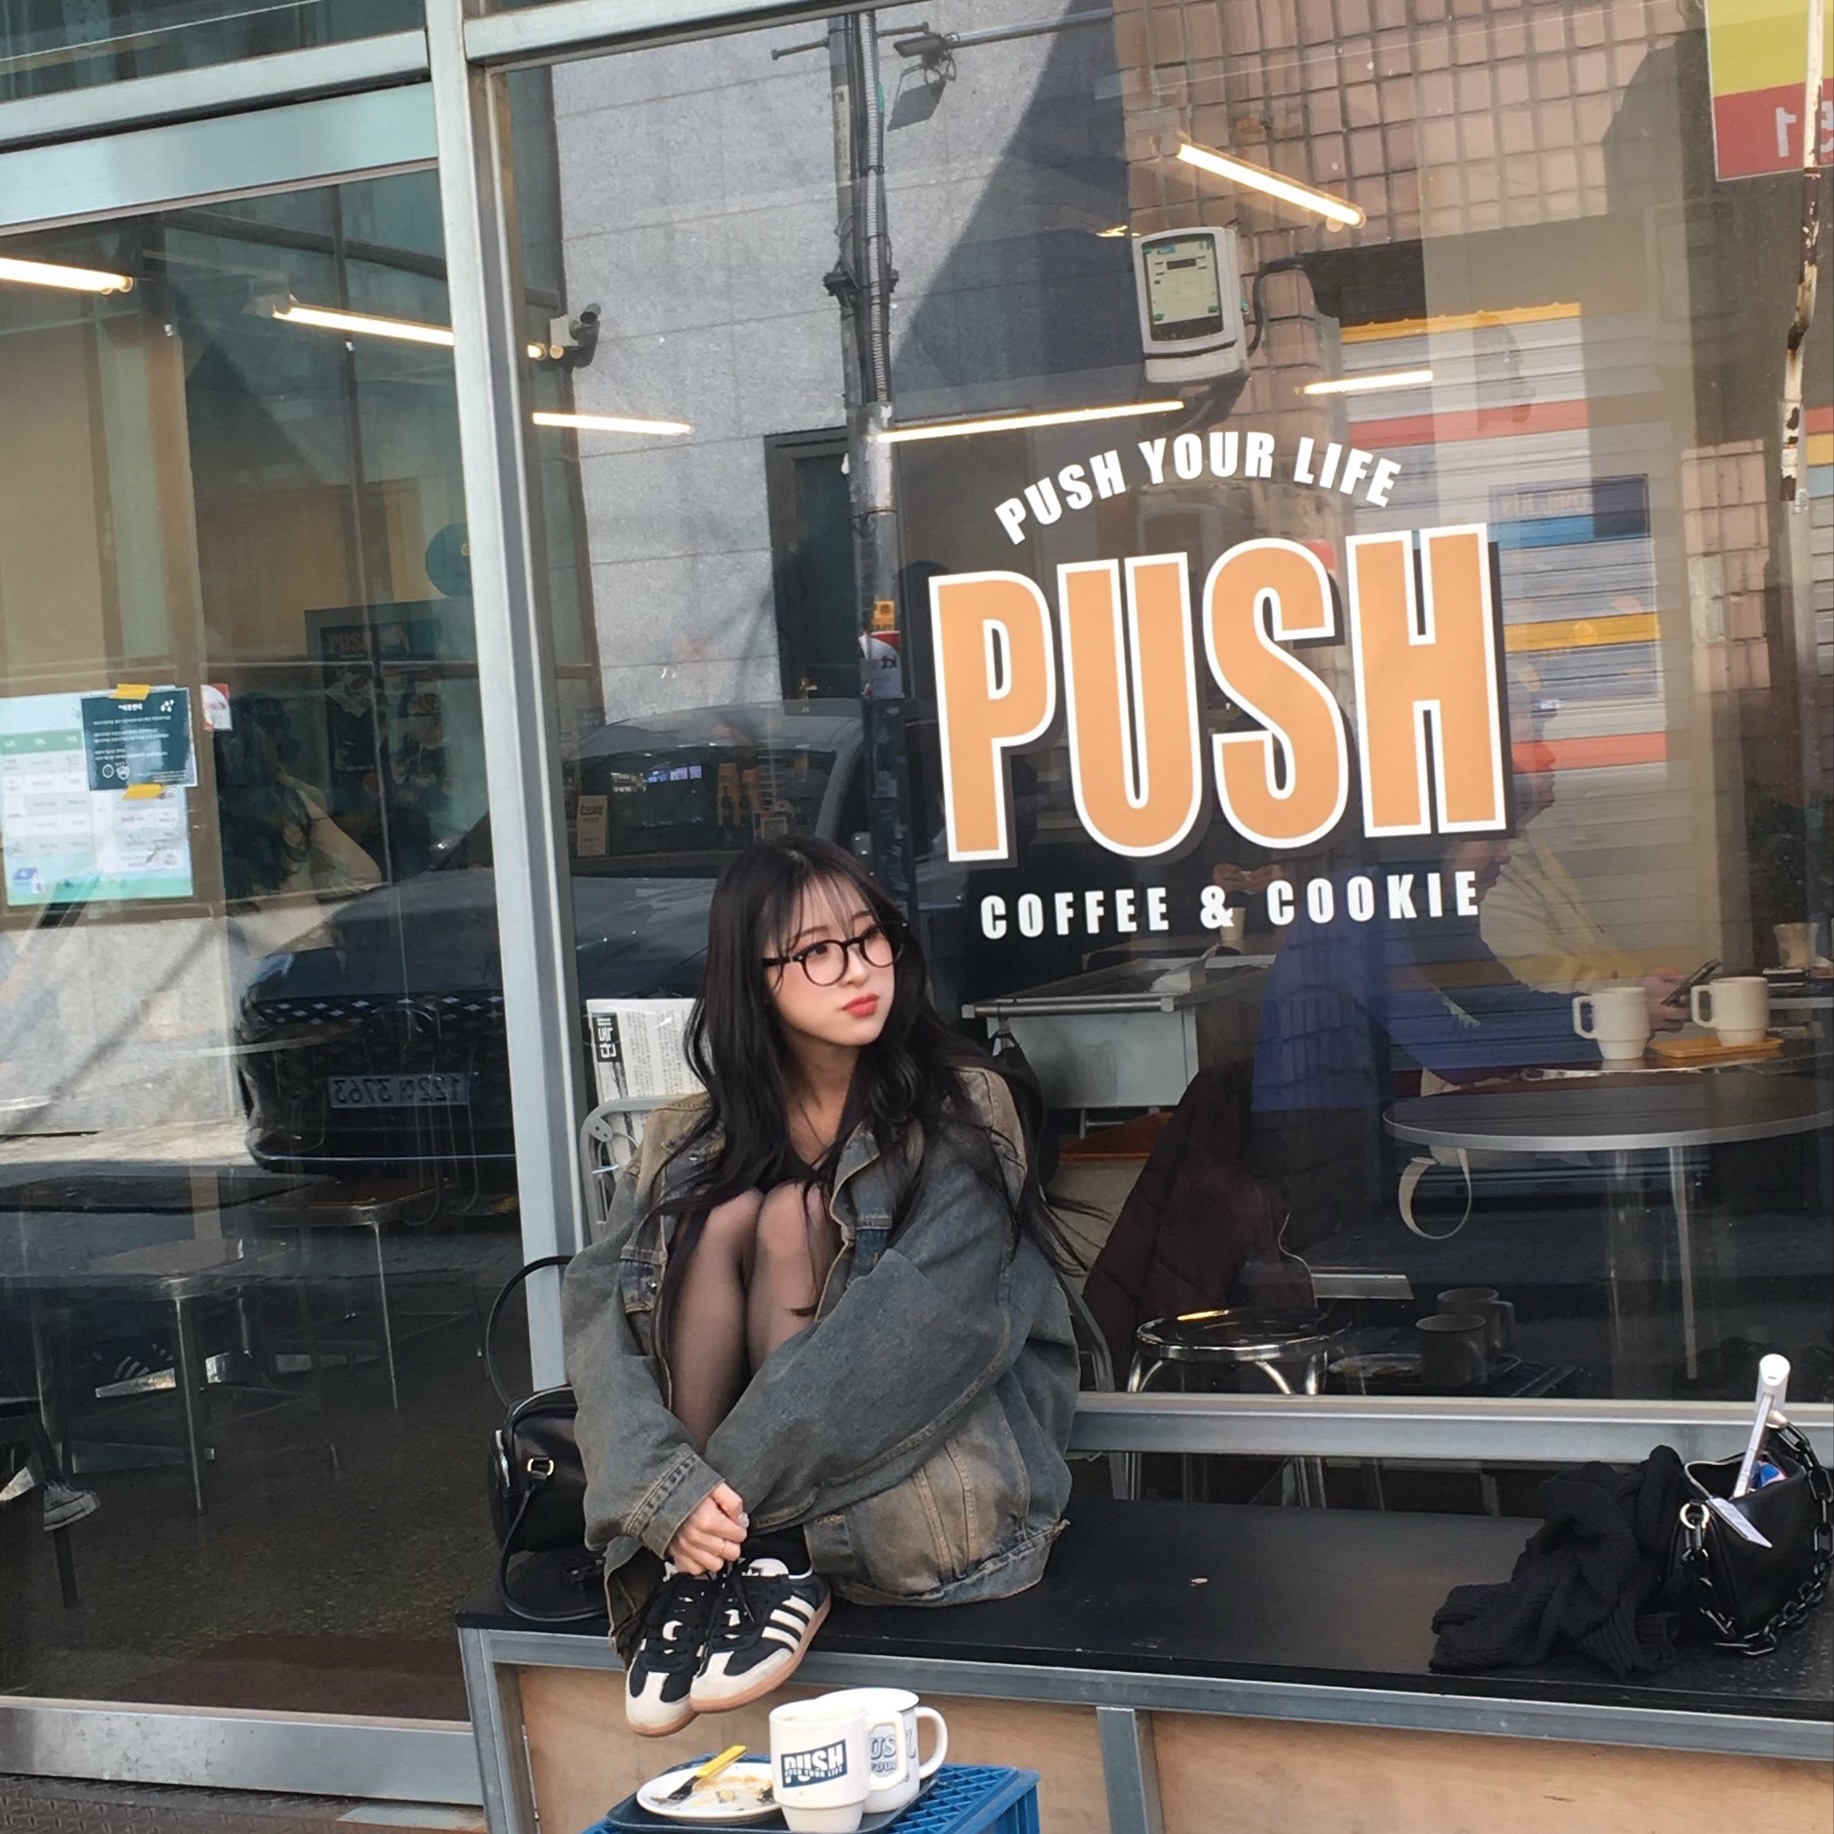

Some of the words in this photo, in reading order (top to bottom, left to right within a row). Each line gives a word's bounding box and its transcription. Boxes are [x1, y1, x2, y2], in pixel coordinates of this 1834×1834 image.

[994, 449, 1126, 545] PUSH
[1139, 431, 1275, 484] YOUR
[1294, 437, 1401, 507] LIFE
[929, 522, 1507, 862] PUSH
[980, 887, 1169, 939] COFFEE
[1200, 884, 1233, 928] &
[1267, 870, 1479, 925] COOKIE
[784, 1743, 844, 1784] PUSH
